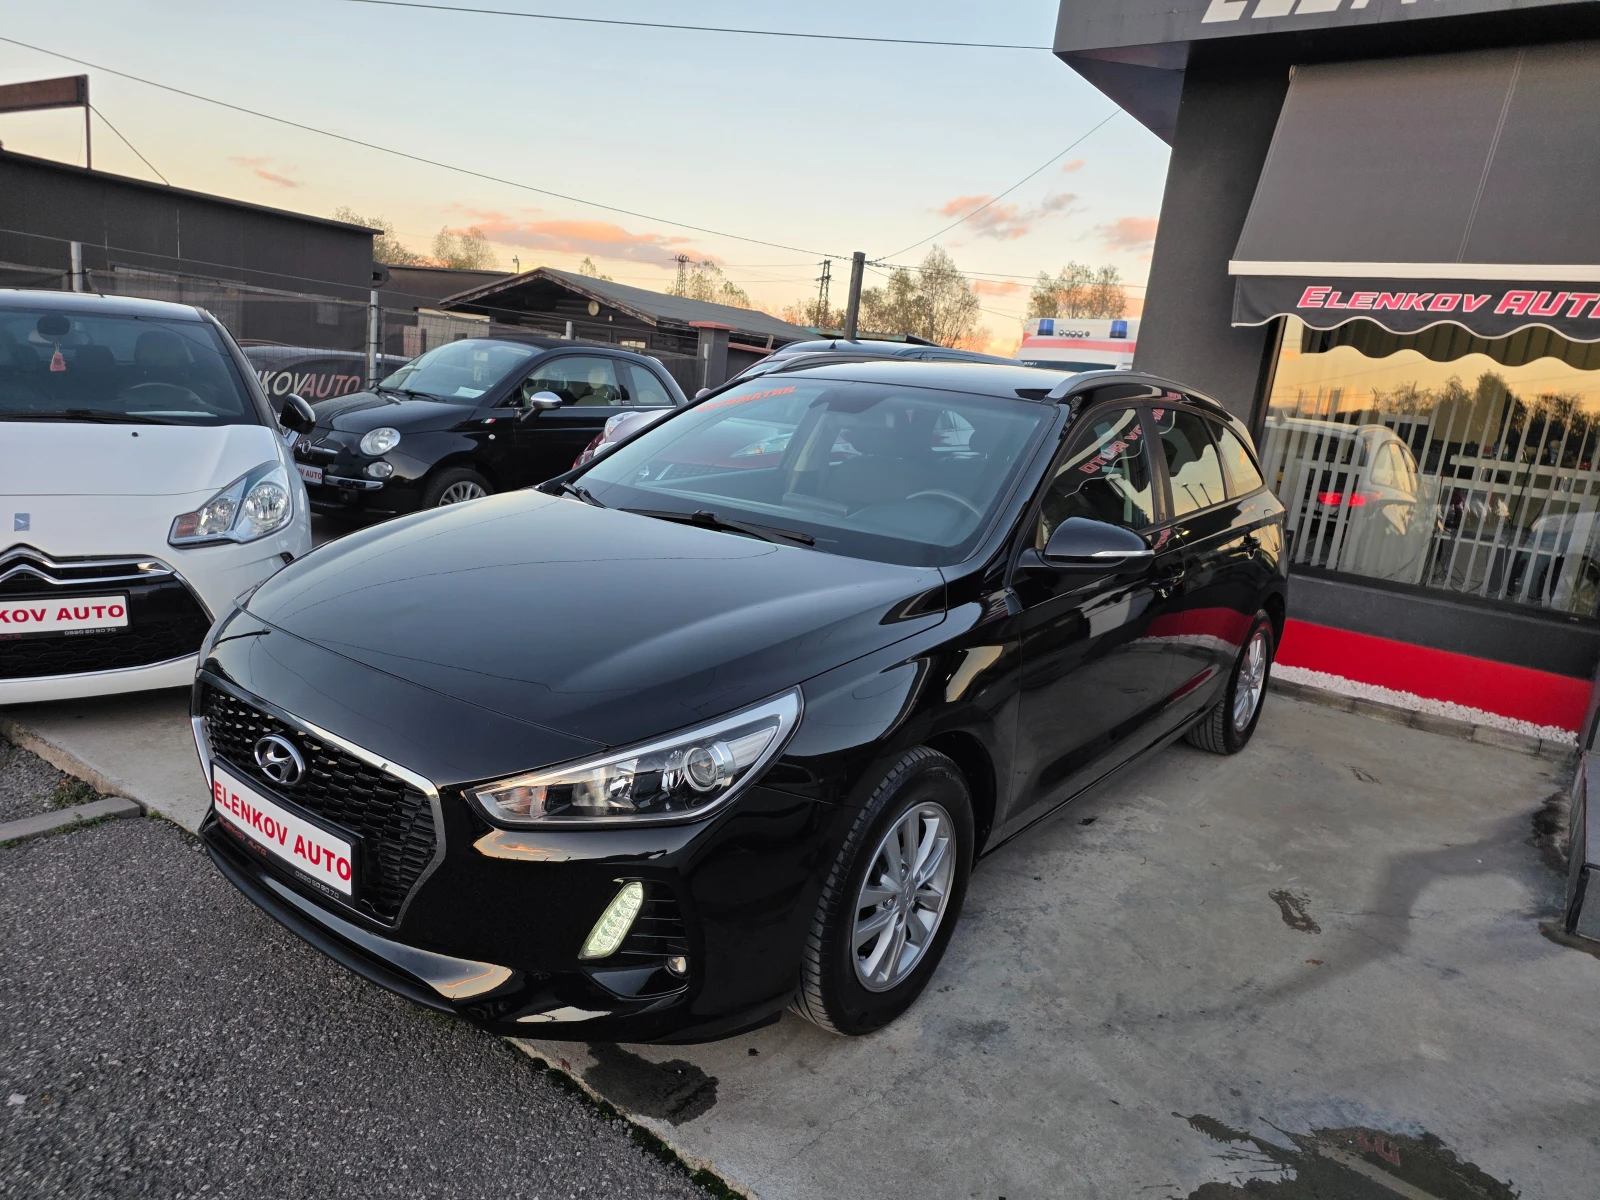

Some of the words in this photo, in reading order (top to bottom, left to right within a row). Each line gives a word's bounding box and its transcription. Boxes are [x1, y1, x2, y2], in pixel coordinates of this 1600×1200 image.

[1297, 286, 1492, 313] ELENKOV
[299, 373, 361, 398] AUTO
[306, 470, 322, 480] AUTO
[56, 604, 124, 621] AUTO
[214, 780, 289, 847] ELENKOV
[293, 833, 352, 882] AUTO
